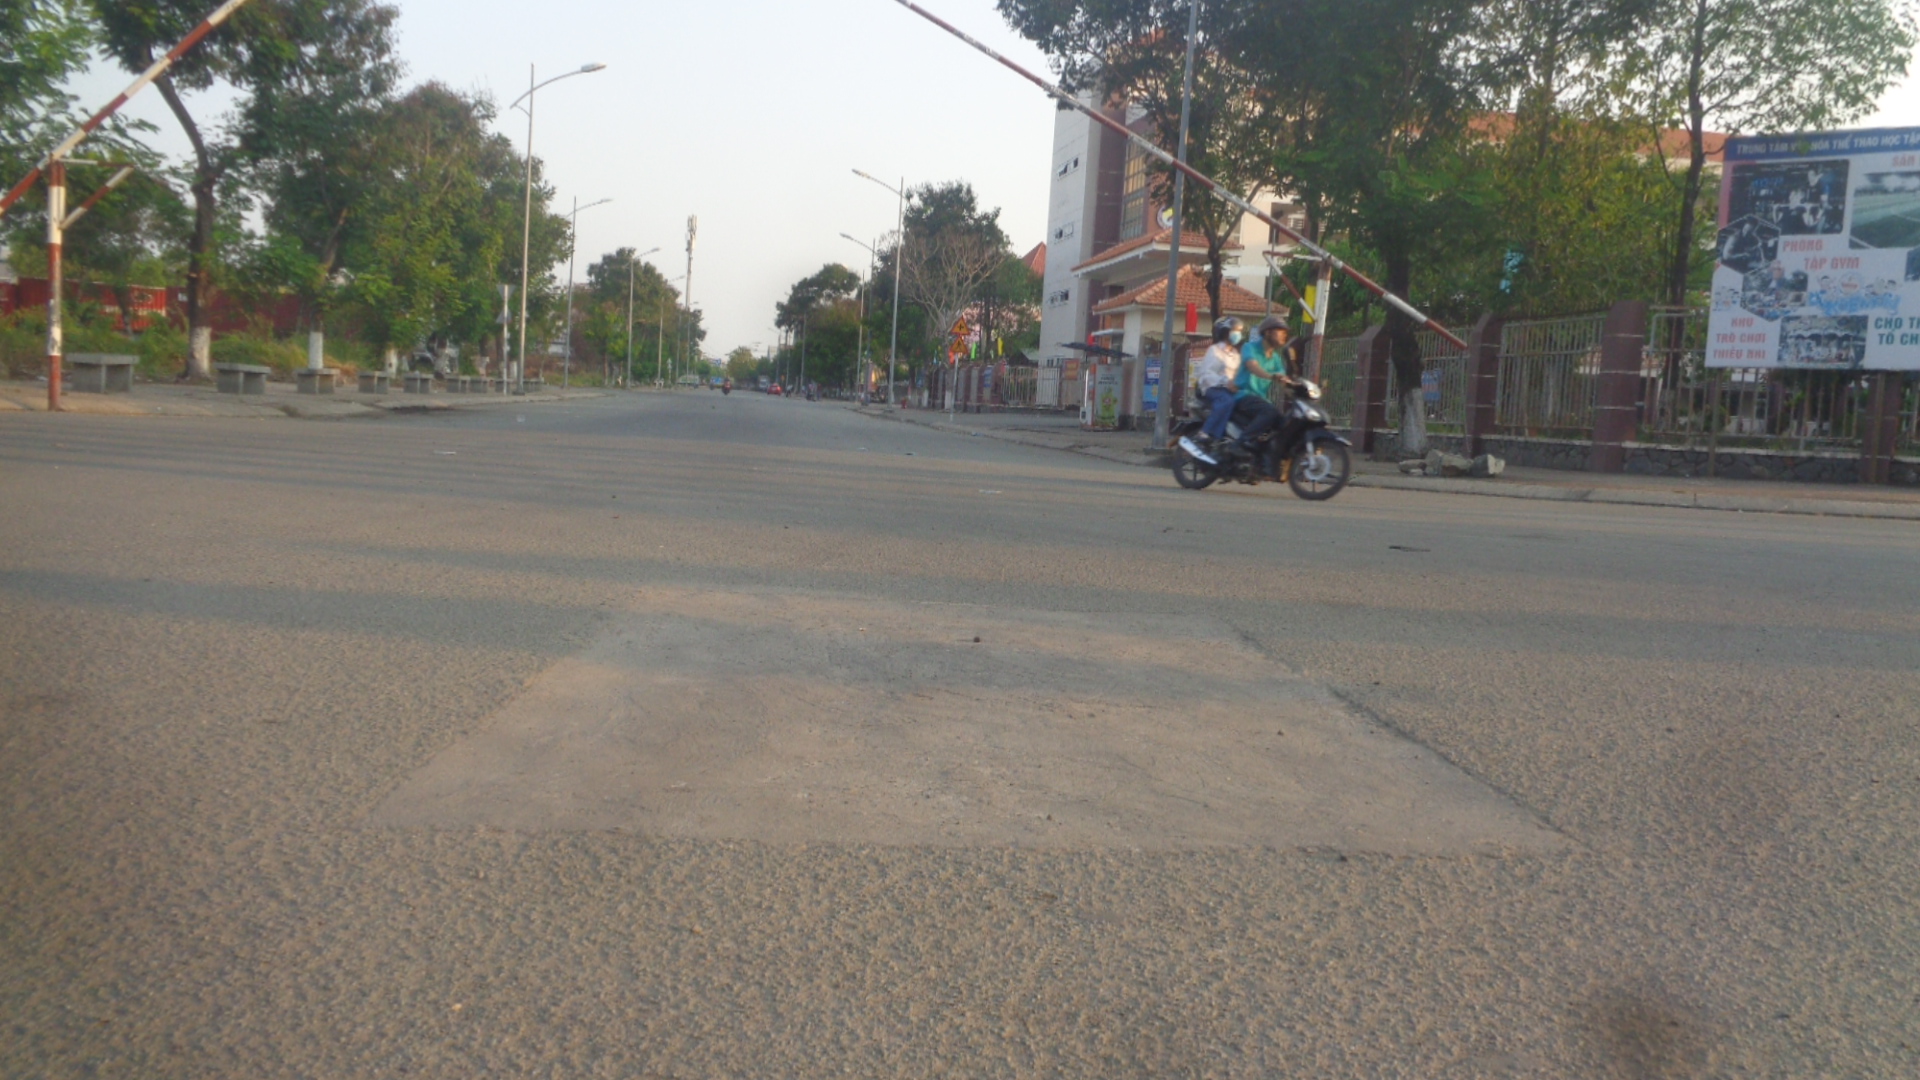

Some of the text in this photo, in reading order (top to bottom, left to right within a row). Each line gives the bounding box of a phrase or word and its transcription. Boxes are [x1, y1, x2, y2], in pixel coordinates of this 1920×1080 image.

[1737, 143, 1766, 154] TRUNG
[1833, 134, 1853, 150] THẾ
[1854, 136, 1879, 148] THAO
[1881, 135, 1901, 147] HỌC
[1830, 257, 1859, 269] GYM
[1731, 317, 1754, 327] KHU
[1874, 317, 1903, 329] CHO
[1747, 349, 1766, 359] NHI
